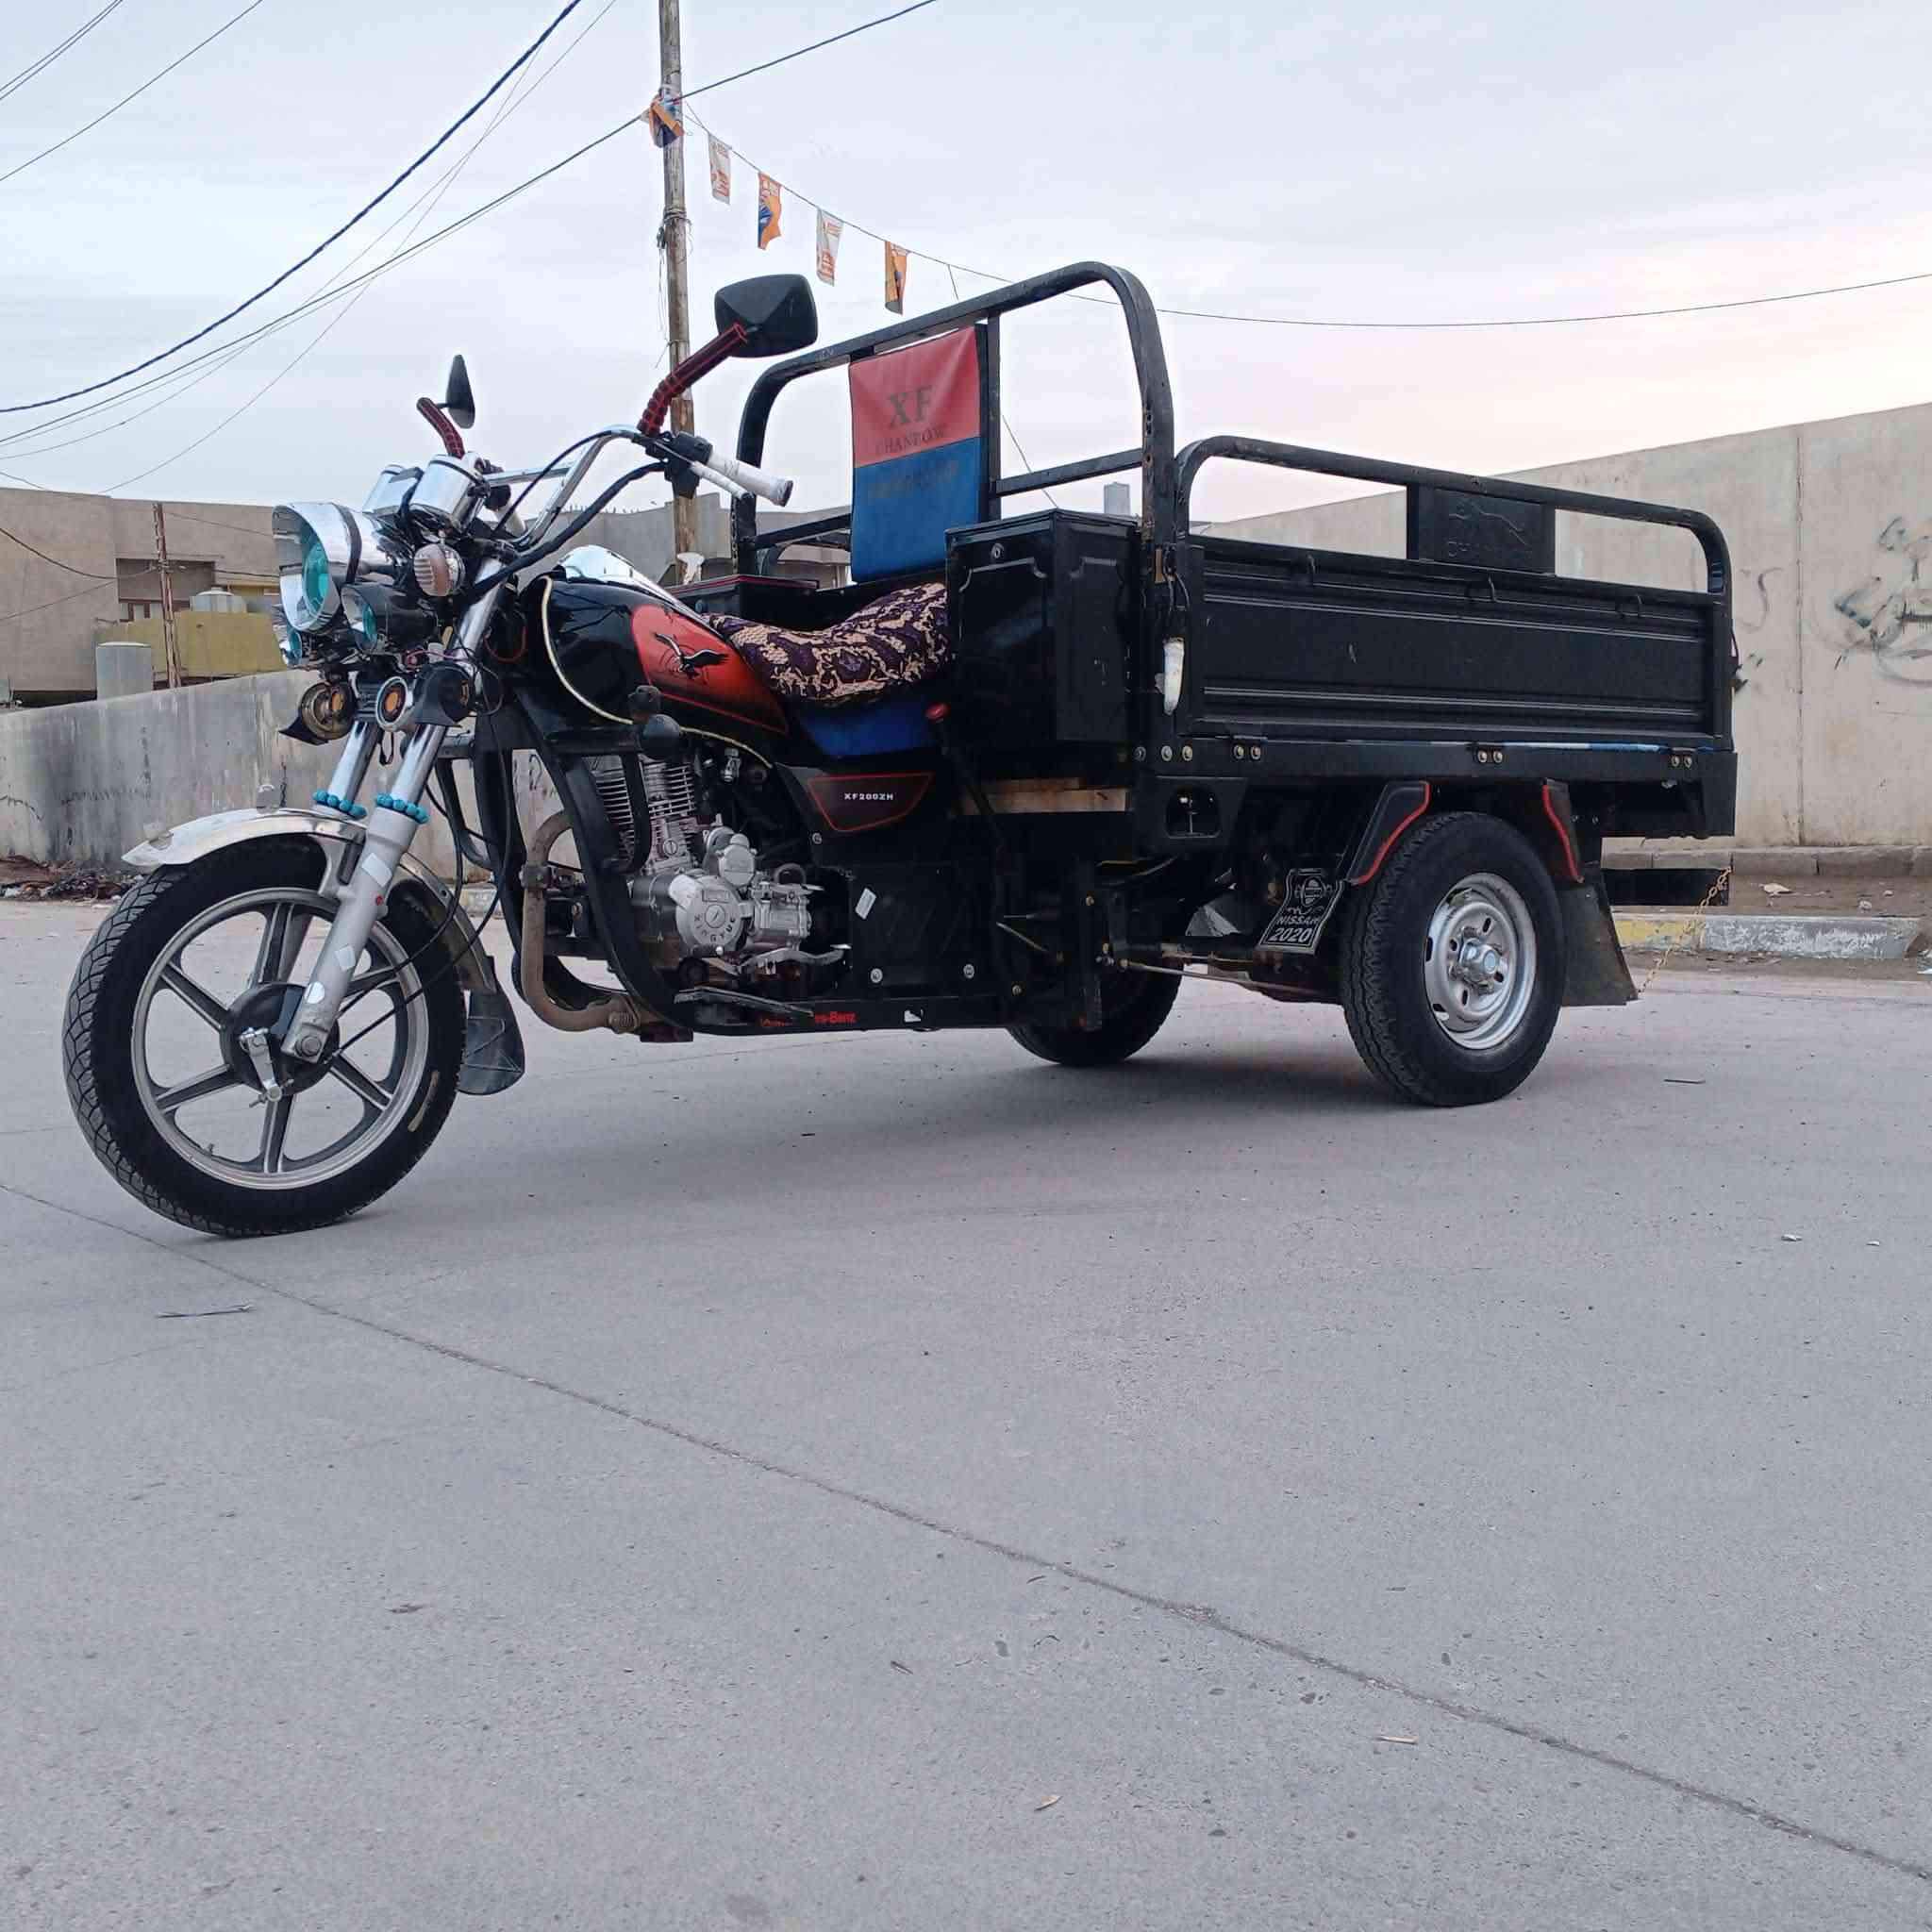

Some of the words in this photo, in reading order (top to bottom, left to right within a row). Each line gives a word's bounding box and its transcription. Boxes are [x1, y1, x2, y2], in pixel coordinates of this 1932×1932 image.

[889, 386, 933, 427] XF
[843, 792, 894, 801] XF200ZH
[1275, 914, 1320, 925] NISSAN
[1267, 927, 1313, 943] 2020
